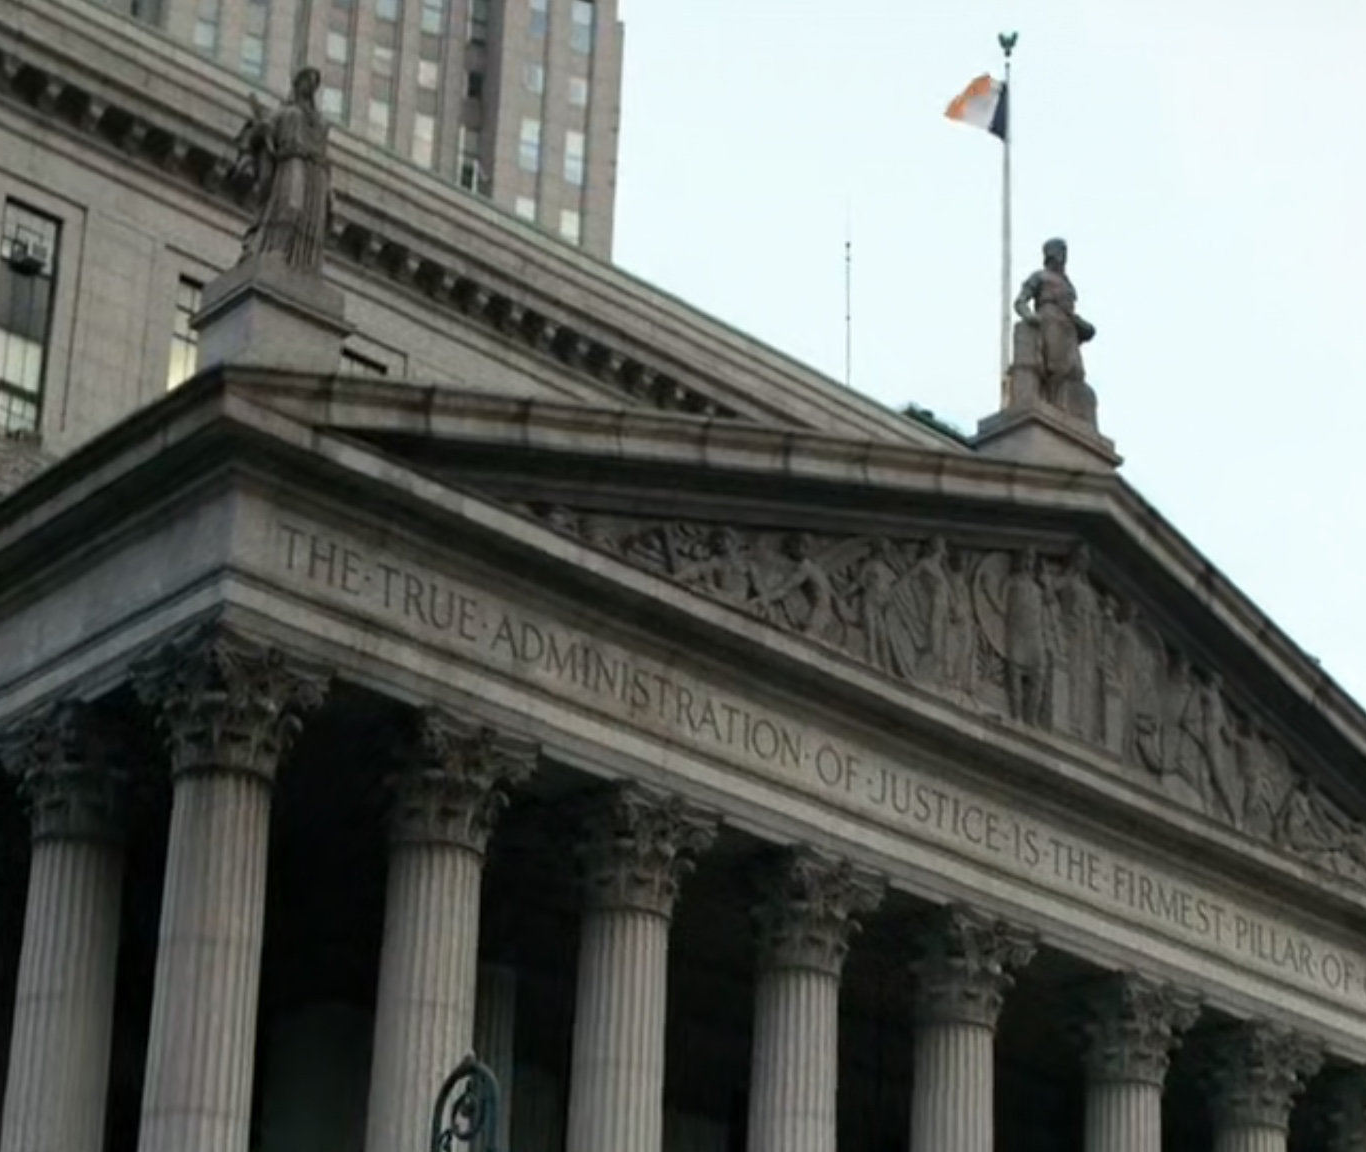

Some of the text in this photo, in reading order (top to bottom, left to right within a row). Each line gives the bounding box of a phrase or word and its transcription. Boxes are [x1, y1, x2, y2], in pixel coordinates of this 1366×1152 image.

[281, 525, 360, 595] THE
[377, 563, 477, 641] TRUE
[490, 615, 802, 767] ADMINISTRATION
[816, 745, 860, 793] OF
[868, 769, 1001, 852] JUSTICE
[1015, 823, 1040, 868] IS
[1048, 837, 1101, 893] THE
[1113, 864, 1225, 944] FIRMEST
[1236, 916, 1314, 978] PILLAR
[1322, 954, 1354, 992] OF
